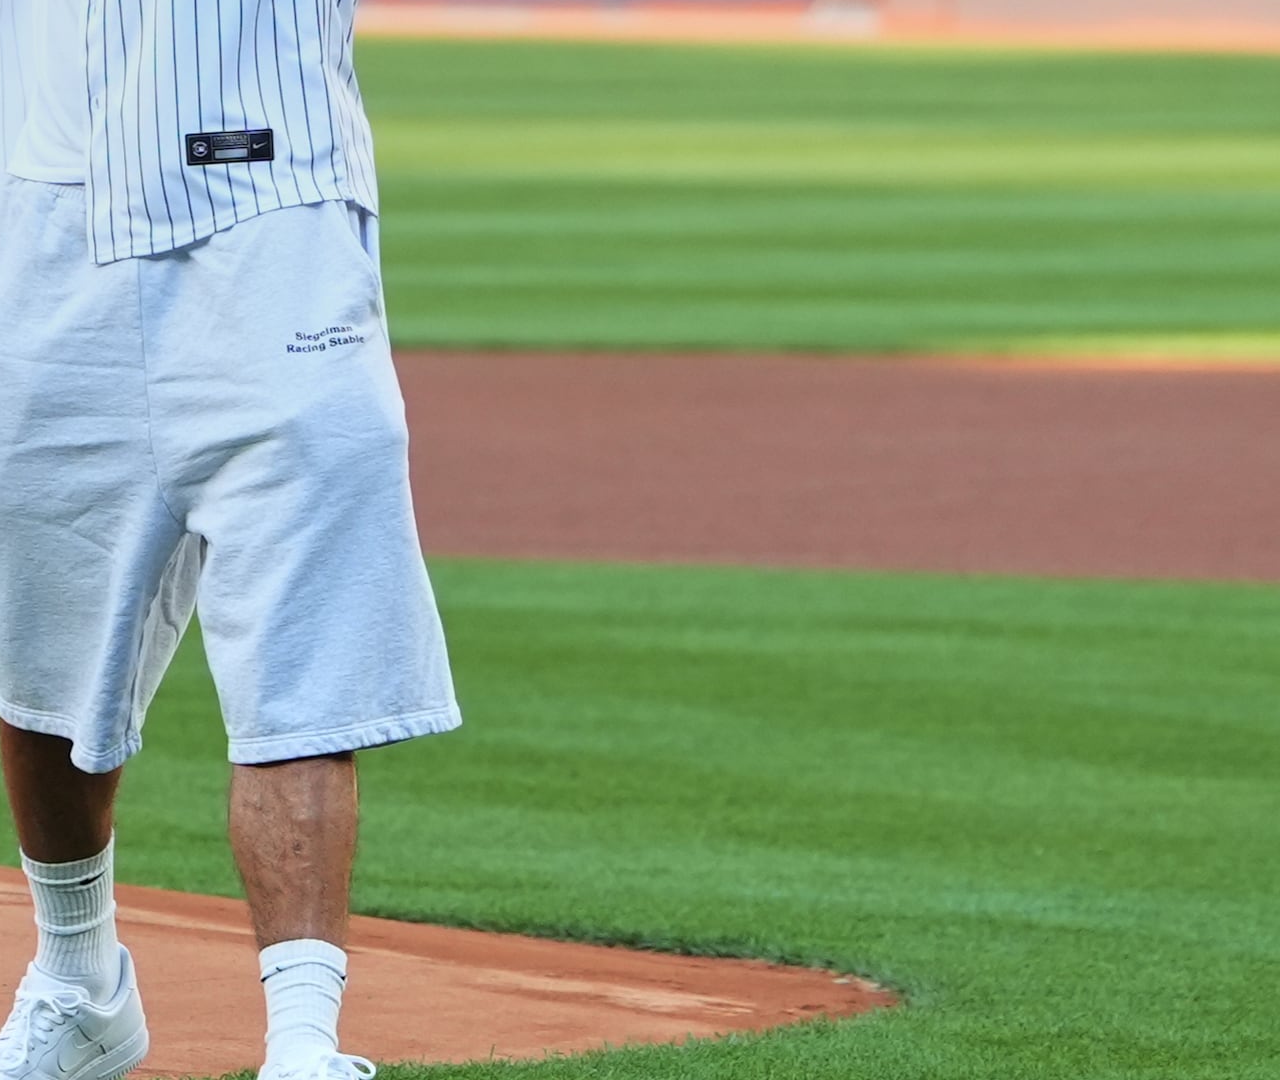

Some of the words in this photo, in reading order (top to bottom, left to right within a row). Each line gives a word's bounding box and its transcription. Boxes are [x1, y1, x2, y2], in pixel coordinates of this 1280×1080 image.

[295, 325, 353, 341] Siegelman
[286, 343, 326, 353] Racing
[328, 335, 365, 347] Stable
